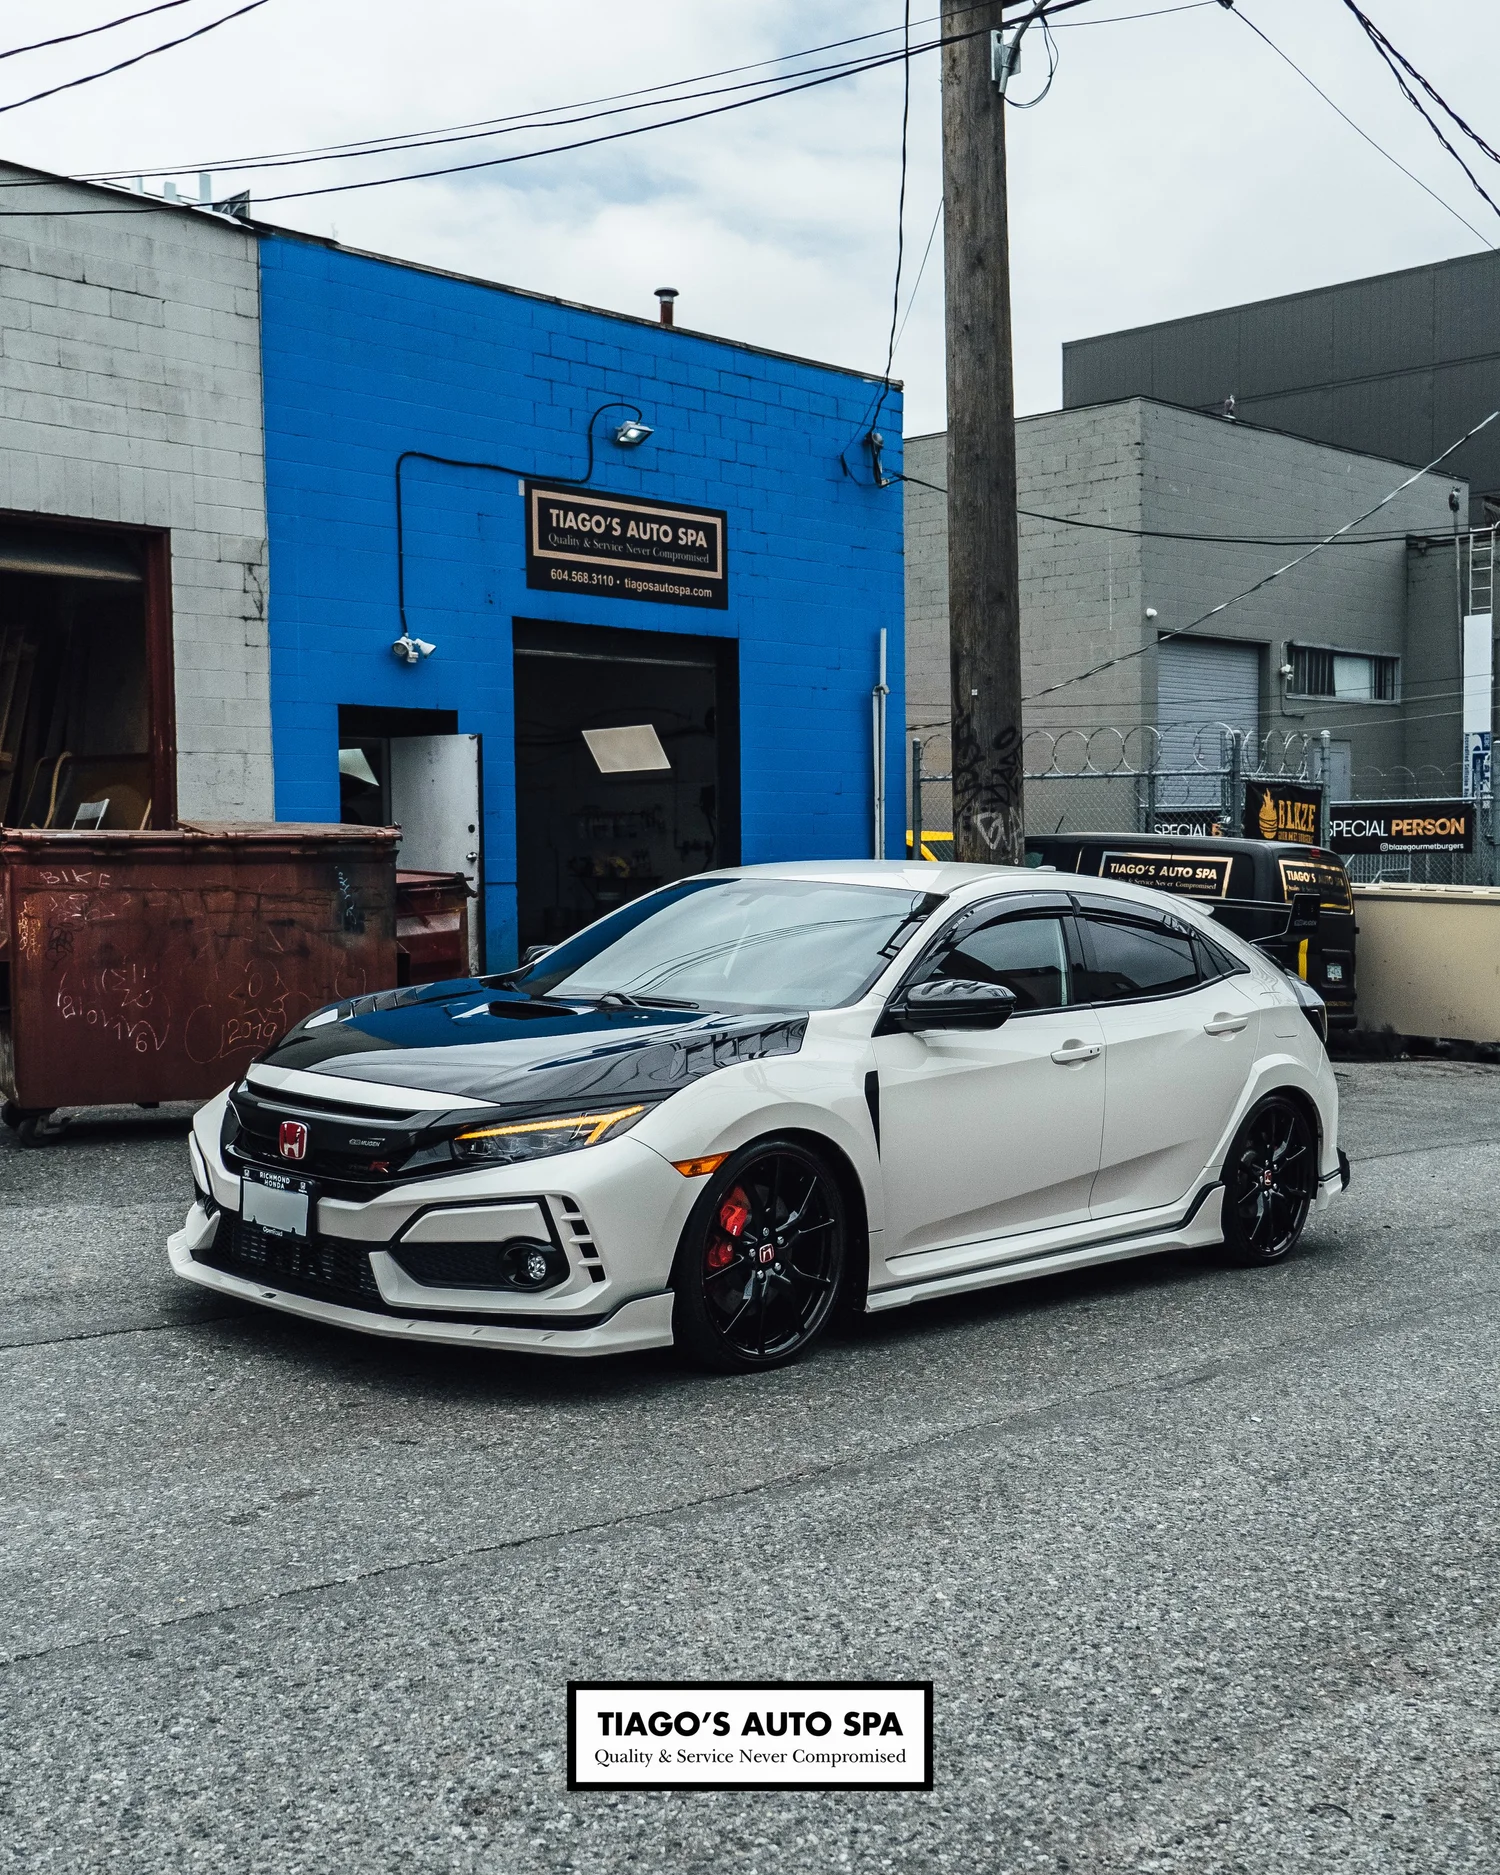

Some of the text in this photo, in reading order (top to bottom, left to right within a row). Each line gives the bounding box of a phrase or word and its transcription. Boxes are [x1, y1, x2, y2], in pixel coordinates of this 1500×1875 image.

[549, 508, 708, 548] TIAGO'S AUTO SPA
[548, 533, 710, 564] Quality & Service Never Compromised
[550, 568, 713, 598] 604.568.3110 tiagosautospa.com
[1278, 800, 1316, 832] BLAZE
[1391, 817, 1465, 837] PERSON
[40, 869, 110, 889] BIKE
[1110, 863, 1217, 880] TIAGO'S AUTO SPA
[1134, 878, 1154, 886] Service
[1154, 879, 1173, 887] Never
[1175, 882, 1217, 890] Compromised
[228, 1019, 277, 1045] 2019
[260, 1171, 290, 1185] RICHMOND
[264, 1180, 285, 1189] HONDA
